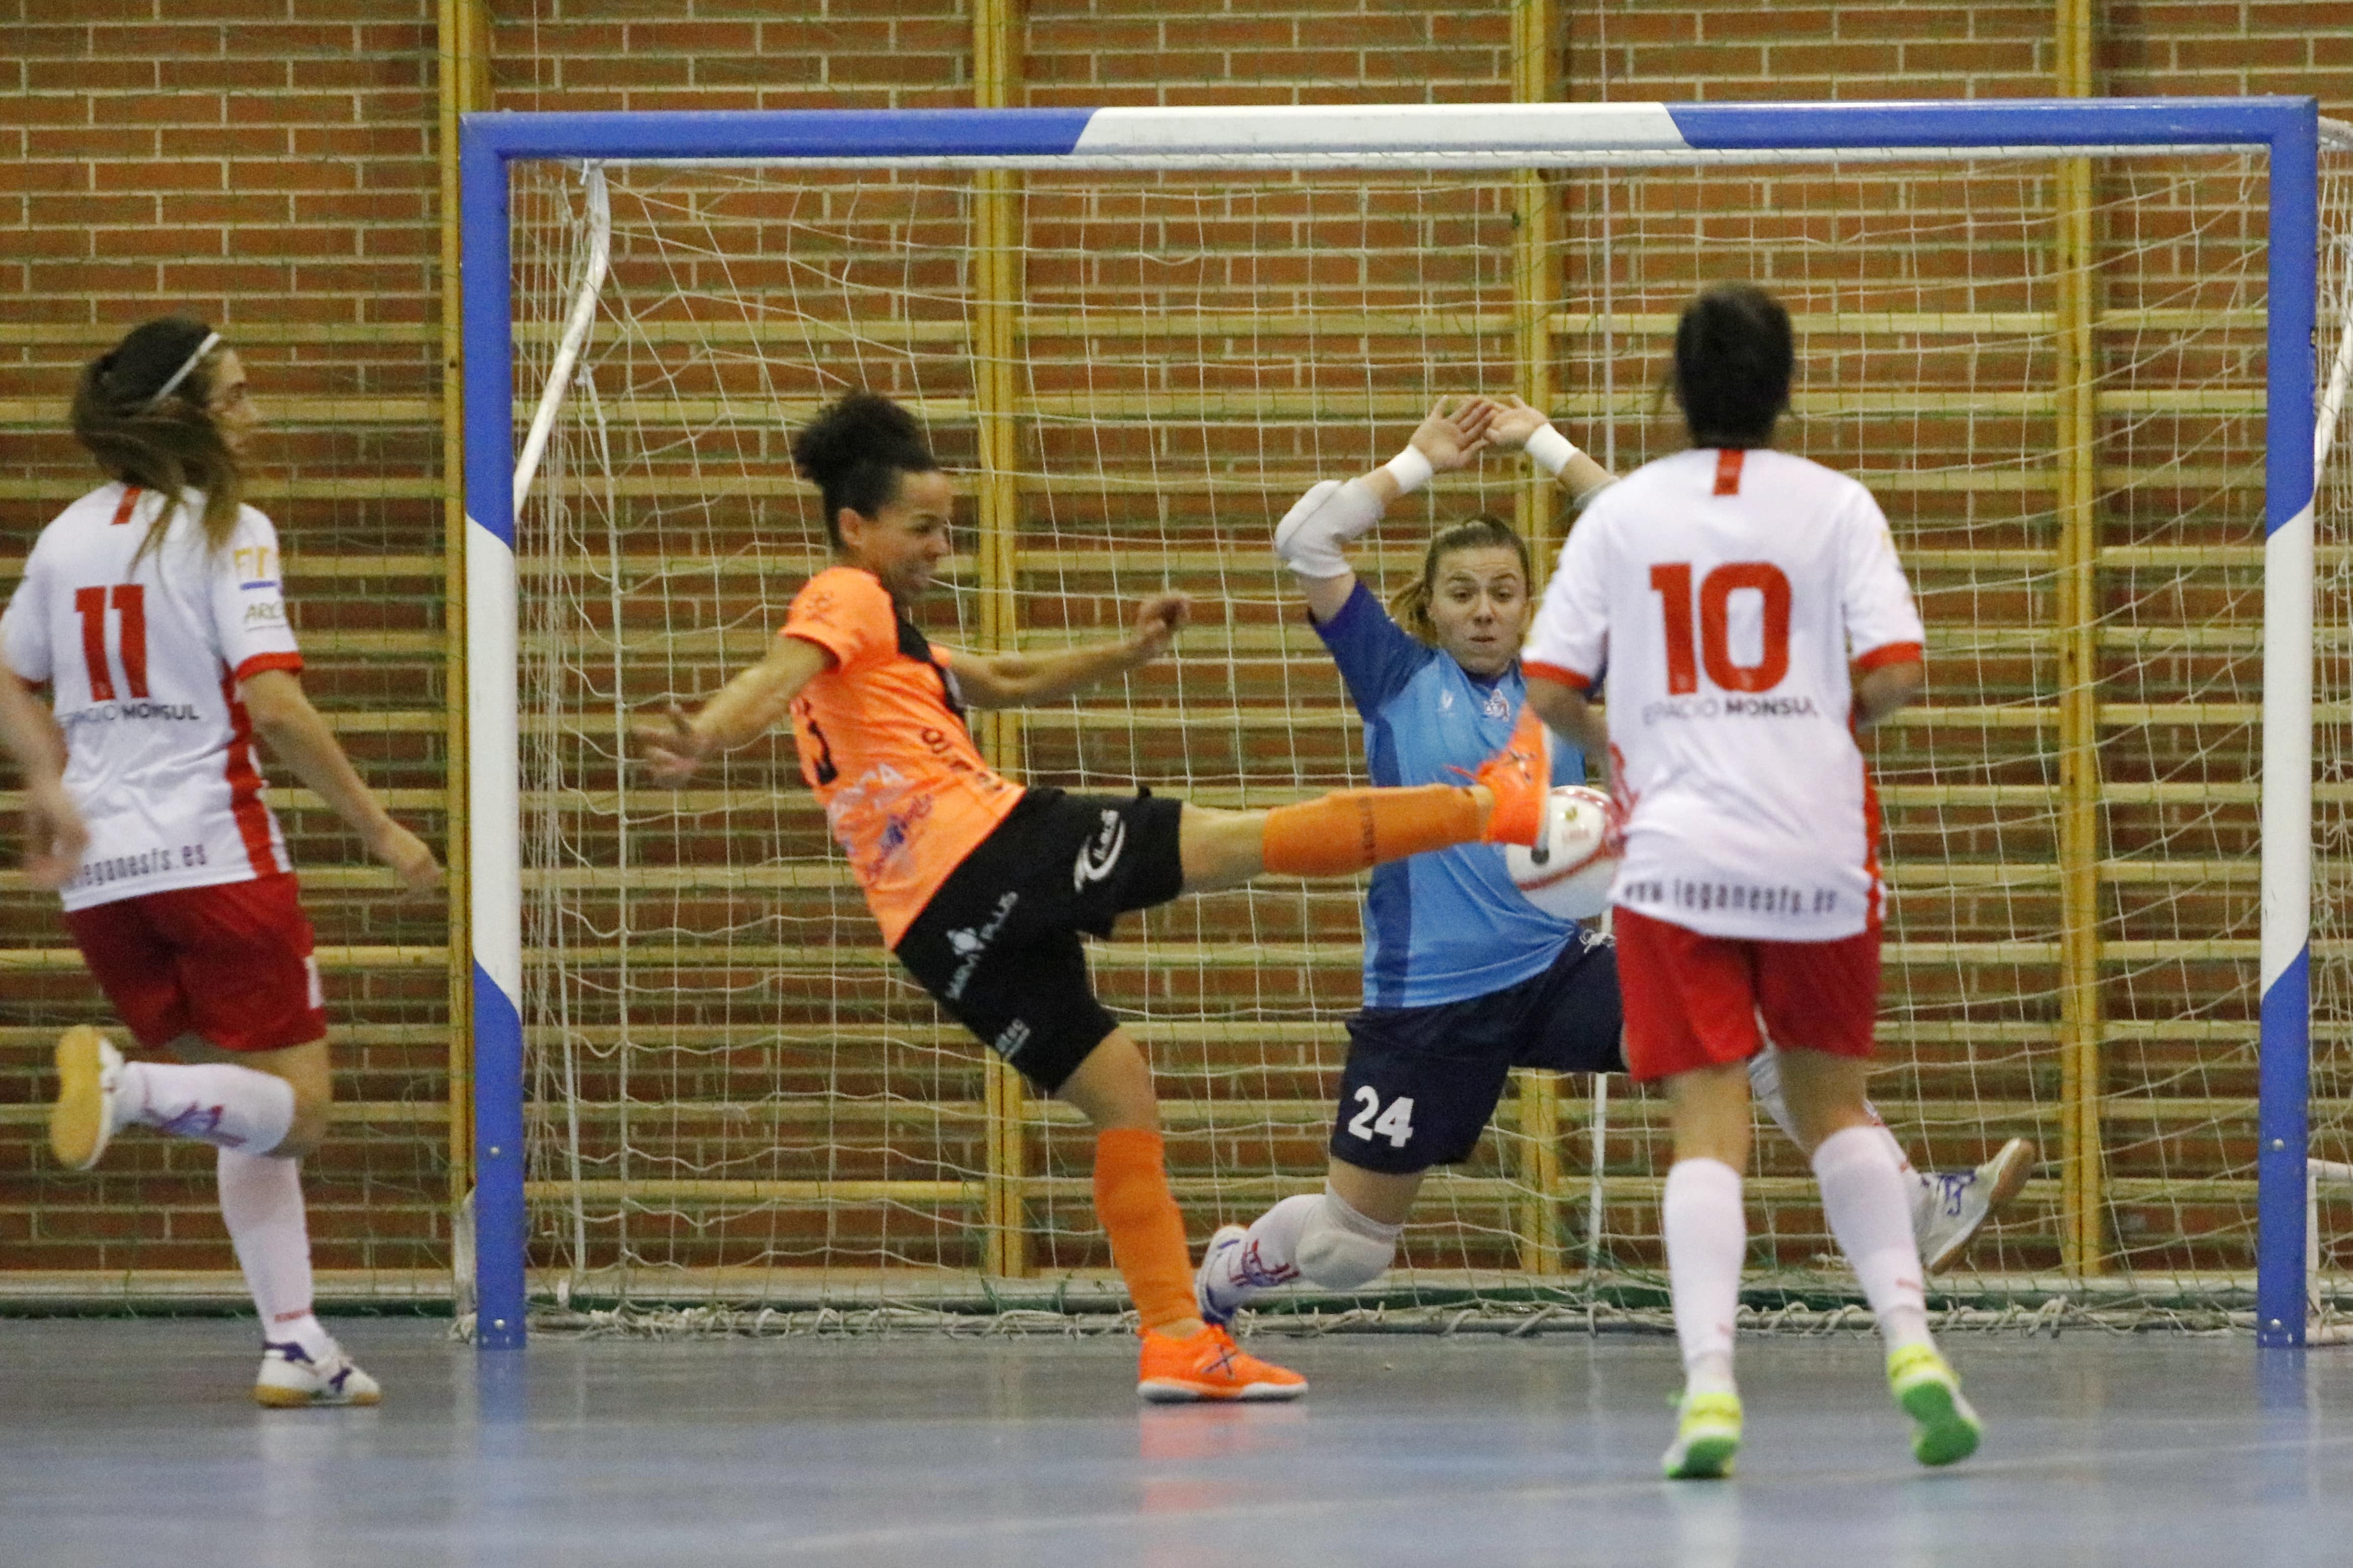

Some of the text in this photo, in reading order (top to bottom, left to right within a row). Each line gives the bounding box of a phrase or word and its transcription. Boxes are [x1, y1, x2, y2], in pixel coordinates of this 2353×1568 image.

[74, 584, 149, 702] 11
[1649, 562, 1791, 694] 10
[123, 703, 199, 720] MONSUL
[81, 844, 206, 885] eganesfs.es
[1348, 1085, 1414, 1147] 24
